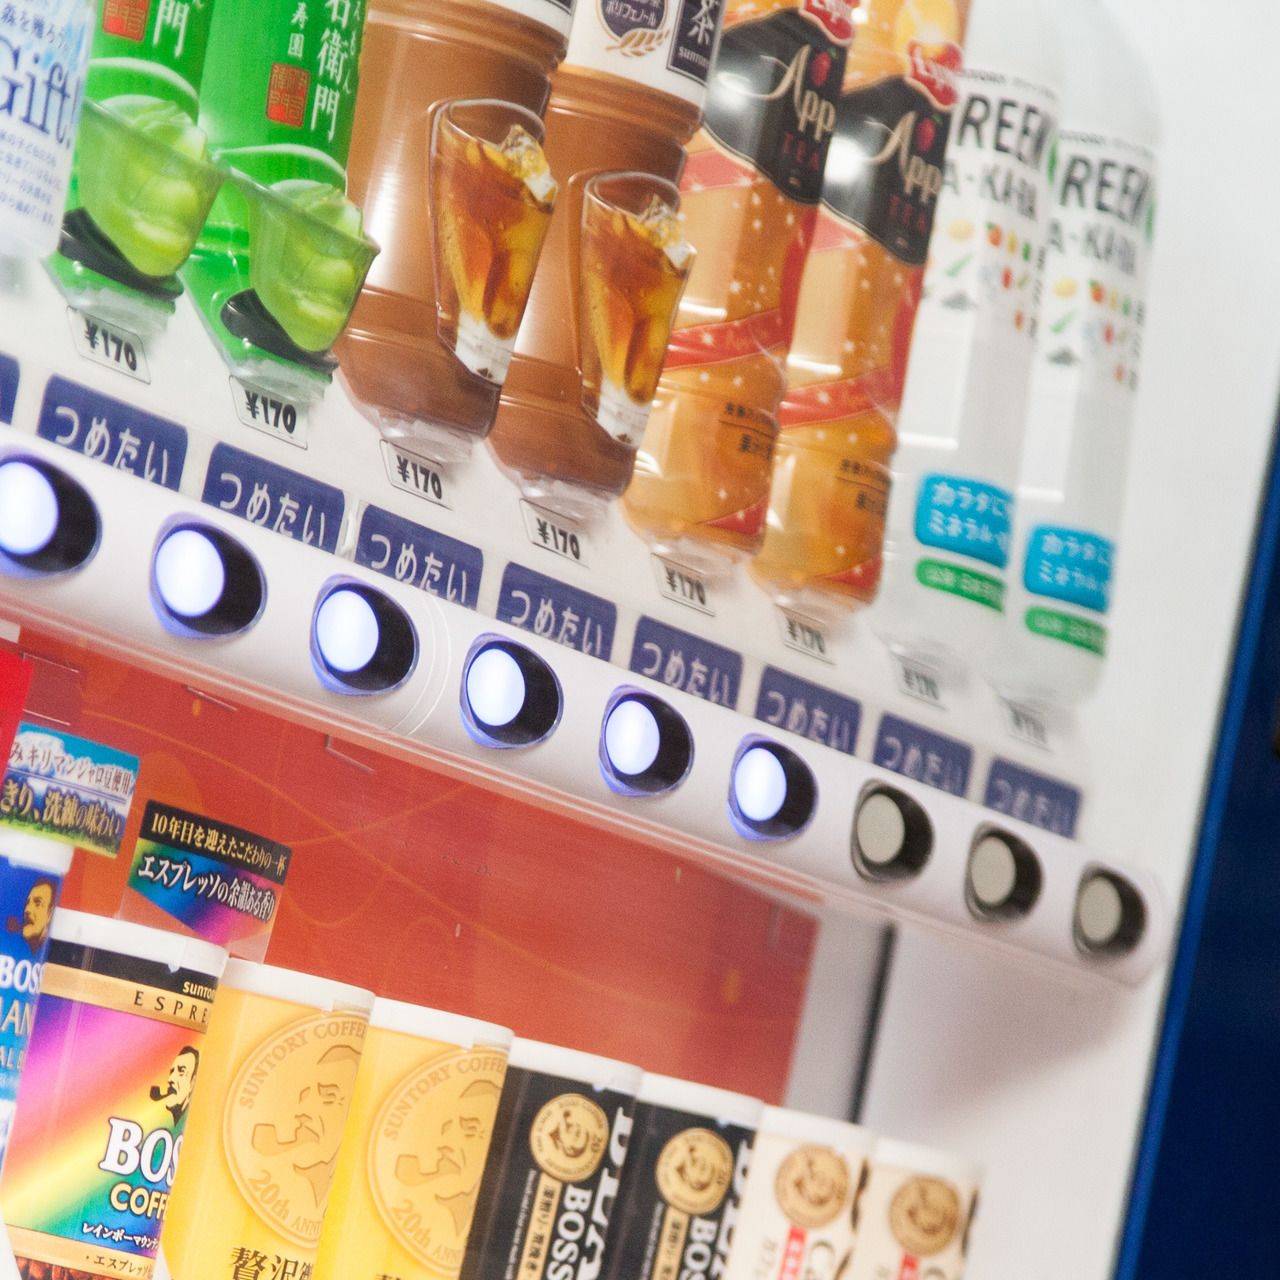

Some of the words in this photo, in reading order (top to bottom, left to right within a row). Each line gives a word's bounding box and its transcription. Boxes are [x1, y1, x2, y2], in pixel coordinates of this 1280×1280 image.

[84, 319, 138, 373] ¥170
[53, 405, 169, 485] つめたい
[245, 389, 298, 436] ¥170
[219, 471, 326, 548] つめたい
[396, 454, 444, 501] ¥170
[369, 533, 470, 605] つめたい
[536, 517, 582, 562] ¥170
[665, 564, 708, 608] ¥170
[508, 589, 604, 656] つめたい
[641, 640, 732, 705] つめたい
[151, 812, 287, 878] 10年目を迎えたこだわりの一杯
[137, 854, 276, 923] エスプレッソの余韻ある香り
[238, 1028, 309, 1110] SUNTORY
[382, 1064, 450, 1142] SUNTORY
[249, 1169, 291, 1219] 20th
